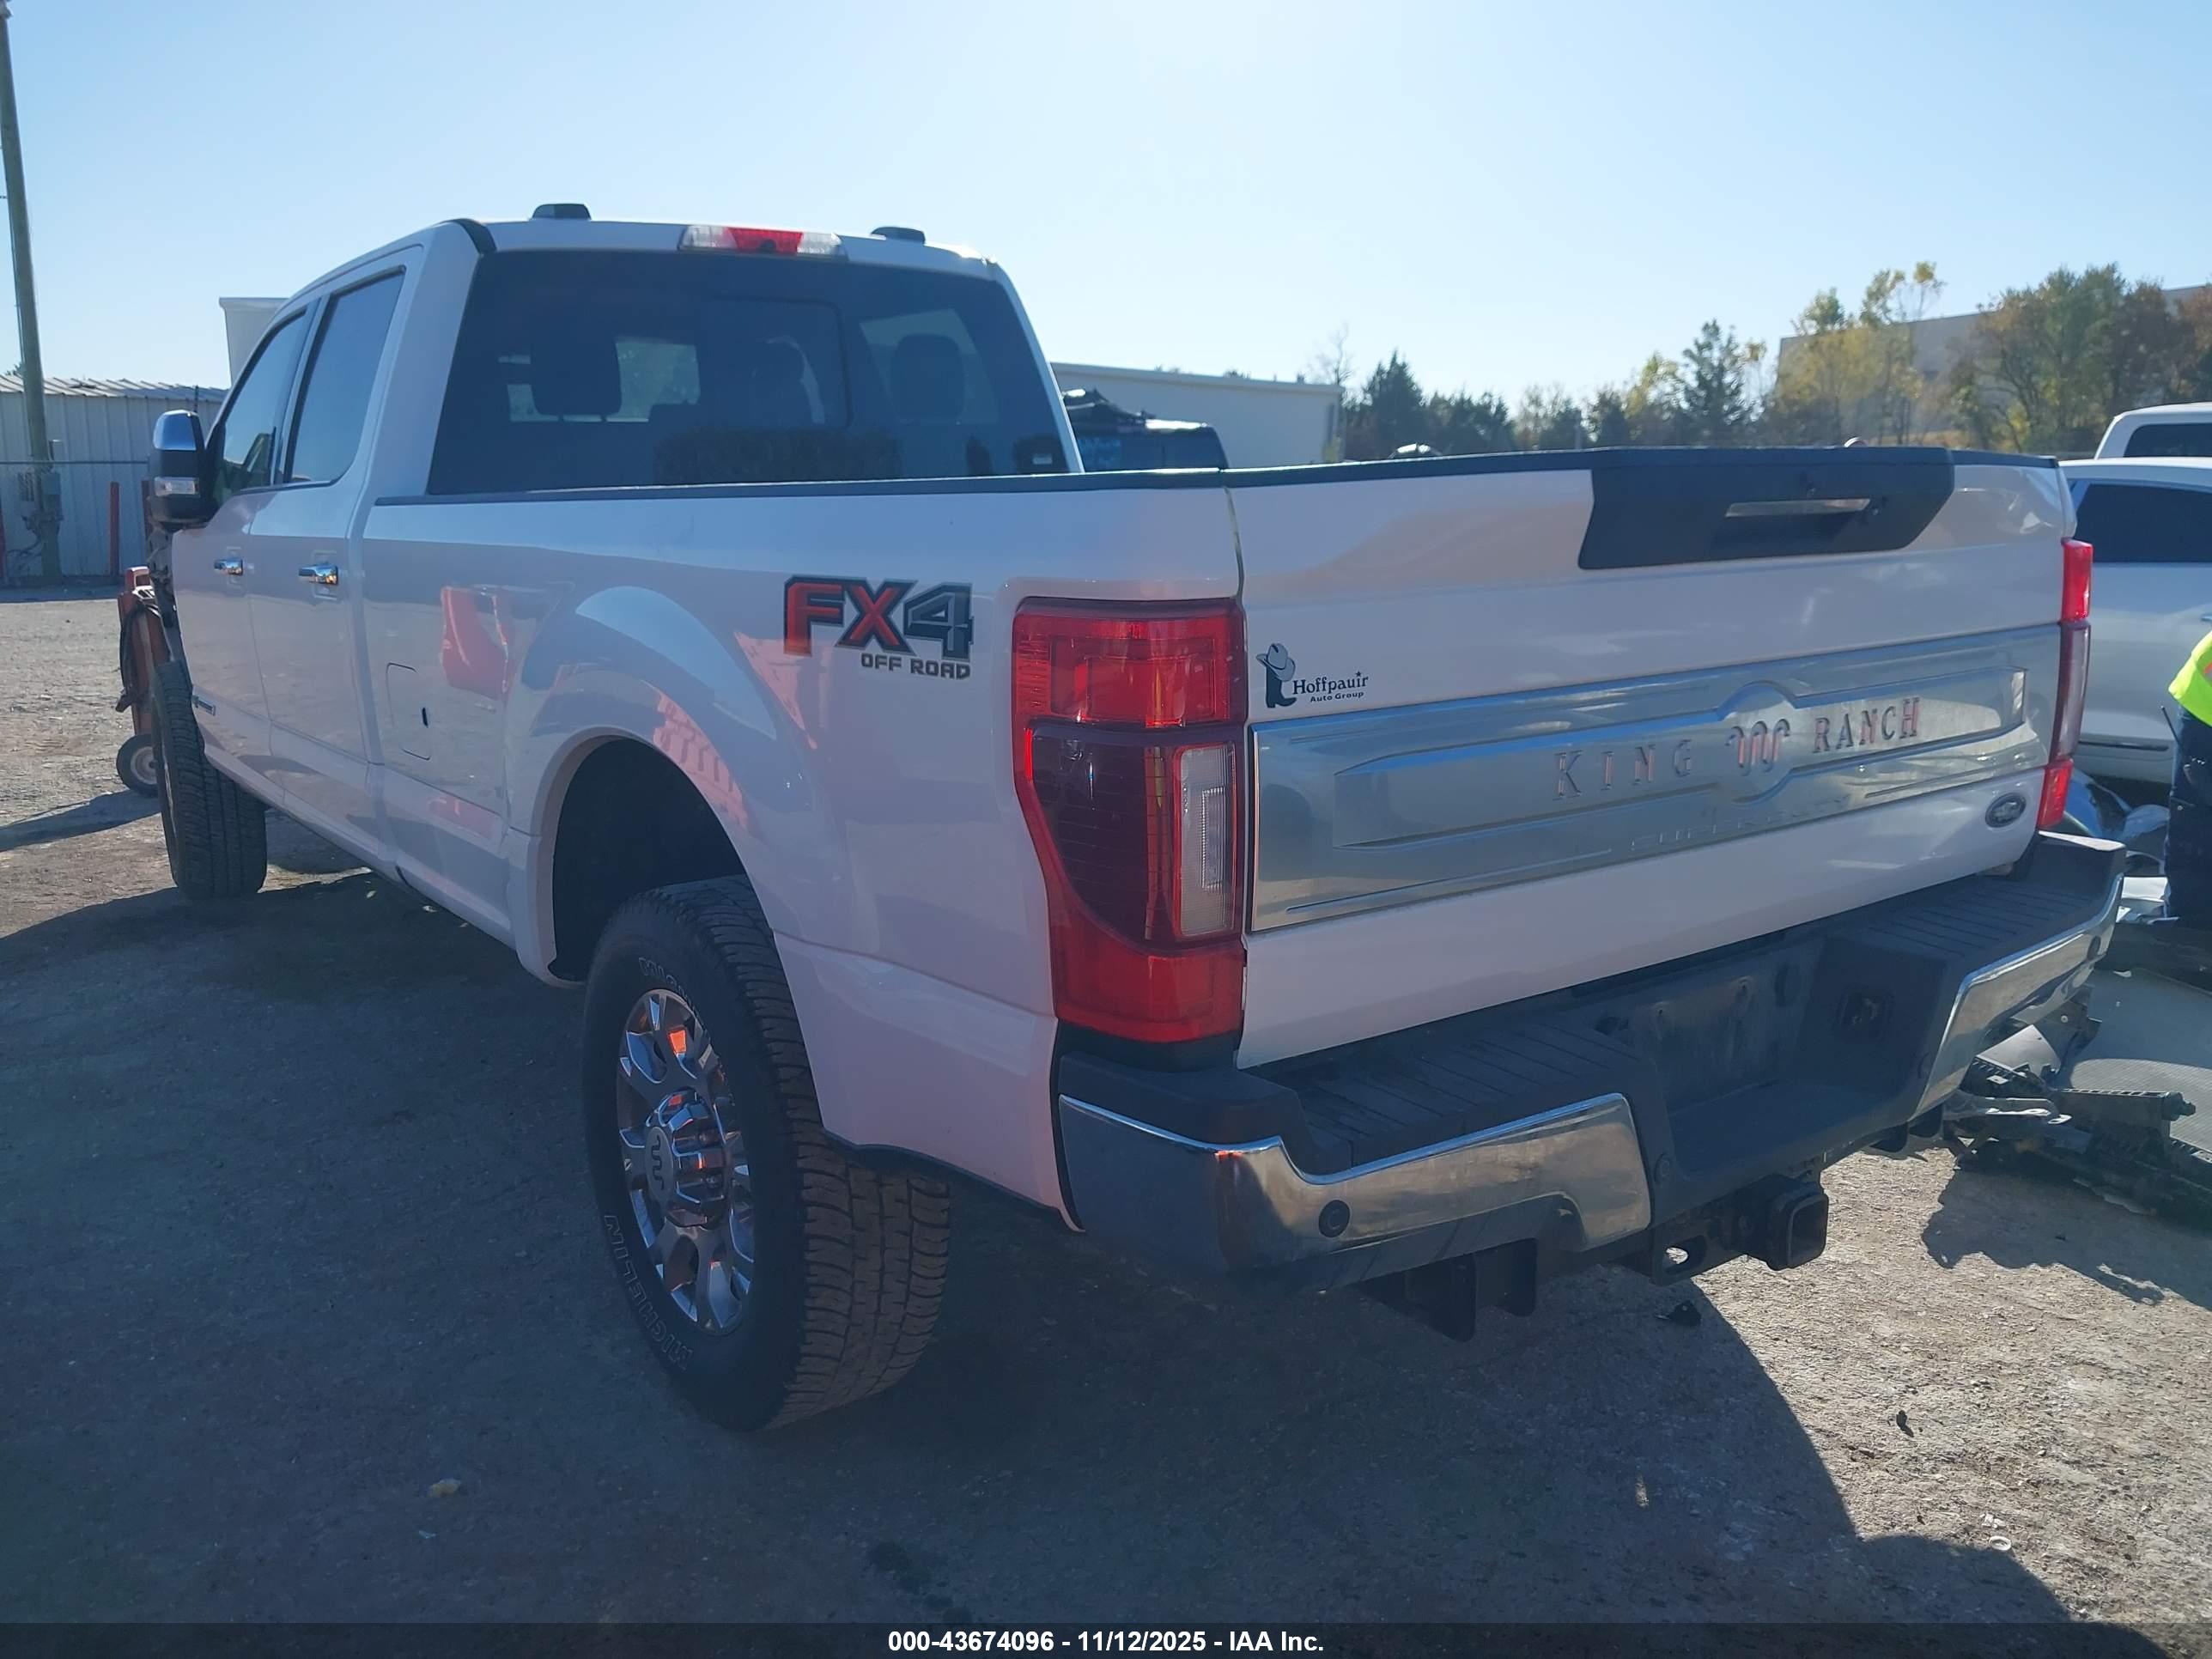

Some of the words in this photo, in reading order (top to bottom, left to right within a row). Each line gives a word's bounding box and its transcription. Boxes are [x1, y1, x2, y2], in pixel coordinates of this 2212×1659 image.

[783, 574, 974, 663] FX4
[860, 653, 902, 672] OFF
[910, 658, 971, 680] ROAD
[1292, 672, 1369, 695] Hoffpauir
[1310, 695, 1333, 703] Auto
[1334, 691, 1364, 701] Group
[1553, 738, 1692, 800] KING
[1811, 696, 1921, 754] RANCH
[604, 1214, 694, 1370] MICHELIN
